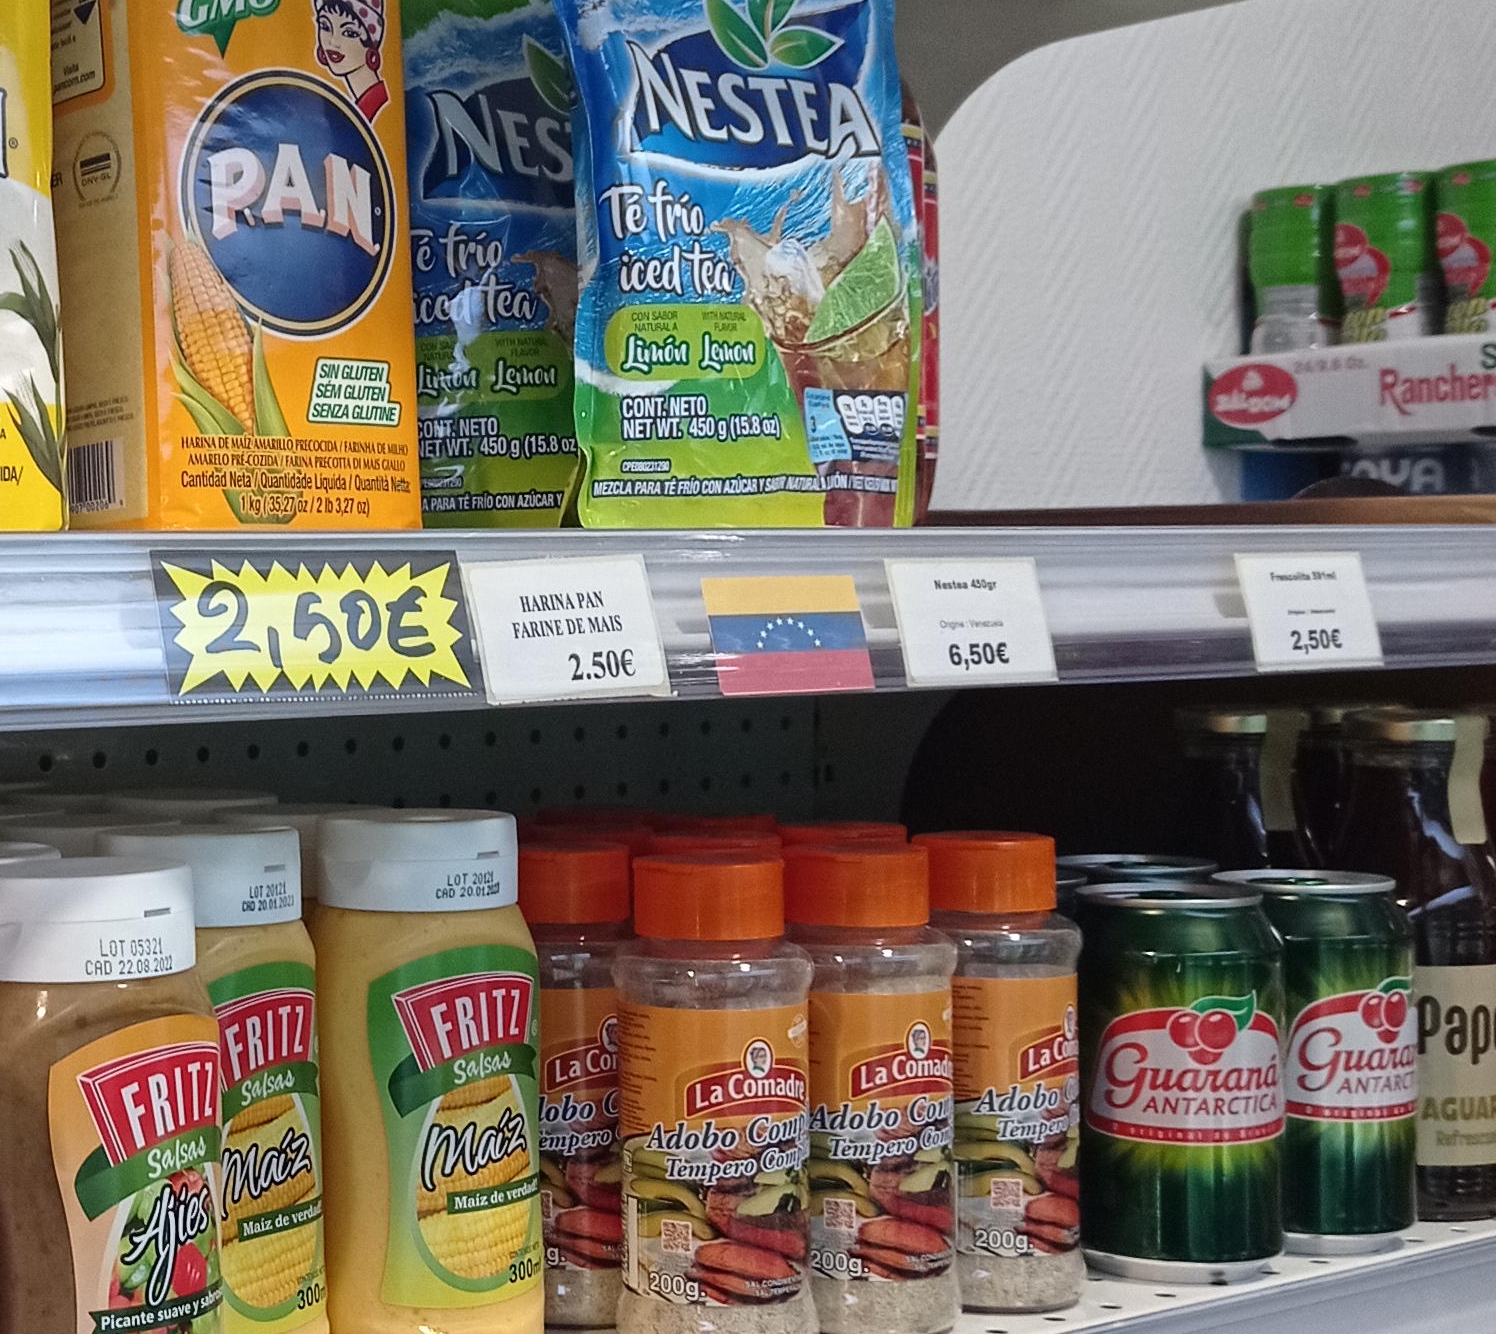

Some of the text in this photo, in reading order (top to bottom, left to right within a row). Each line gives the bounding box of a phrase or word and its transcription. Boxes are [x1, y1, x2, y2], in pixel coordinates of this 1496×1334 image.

[626, 41, 881, 158] NESTEA
[600, 183, 646, 238] Té
[619, 241, 736, 294] iced tea
[623, 333, 756, 373] Limón Lemon
[519, 591, 604, 614] HARINA PAN
[512, 614, 623, 640] FARINE DE MAIS
[1290, 629, 1343, 655] 2,50€
[567, 649, 637, 682] 2.50€
[948, 641, 1010, 670] 6,50€
[99, 937, 163, 956] LOT 05321
[85, 958, 113, 976] CAD
[429, 988, 520, 1059] FRITZ
[453, 1052, 511, 1083] Salsas
[1105, 1042, 1279, 1108] Guaraná
[121, 1058, 214, 1150] FRITZ
[695, 1084, 723, 1108] La
[1143, 1096, 1278, 1116] ANTARCTICA
[422, 1109, 525, 1190] Maíz
[646, 1121, 737, 1150] Adobo
[147, 1136, 206, 1180] Salsas
[666, 1157, 756, 1183] Tempero
